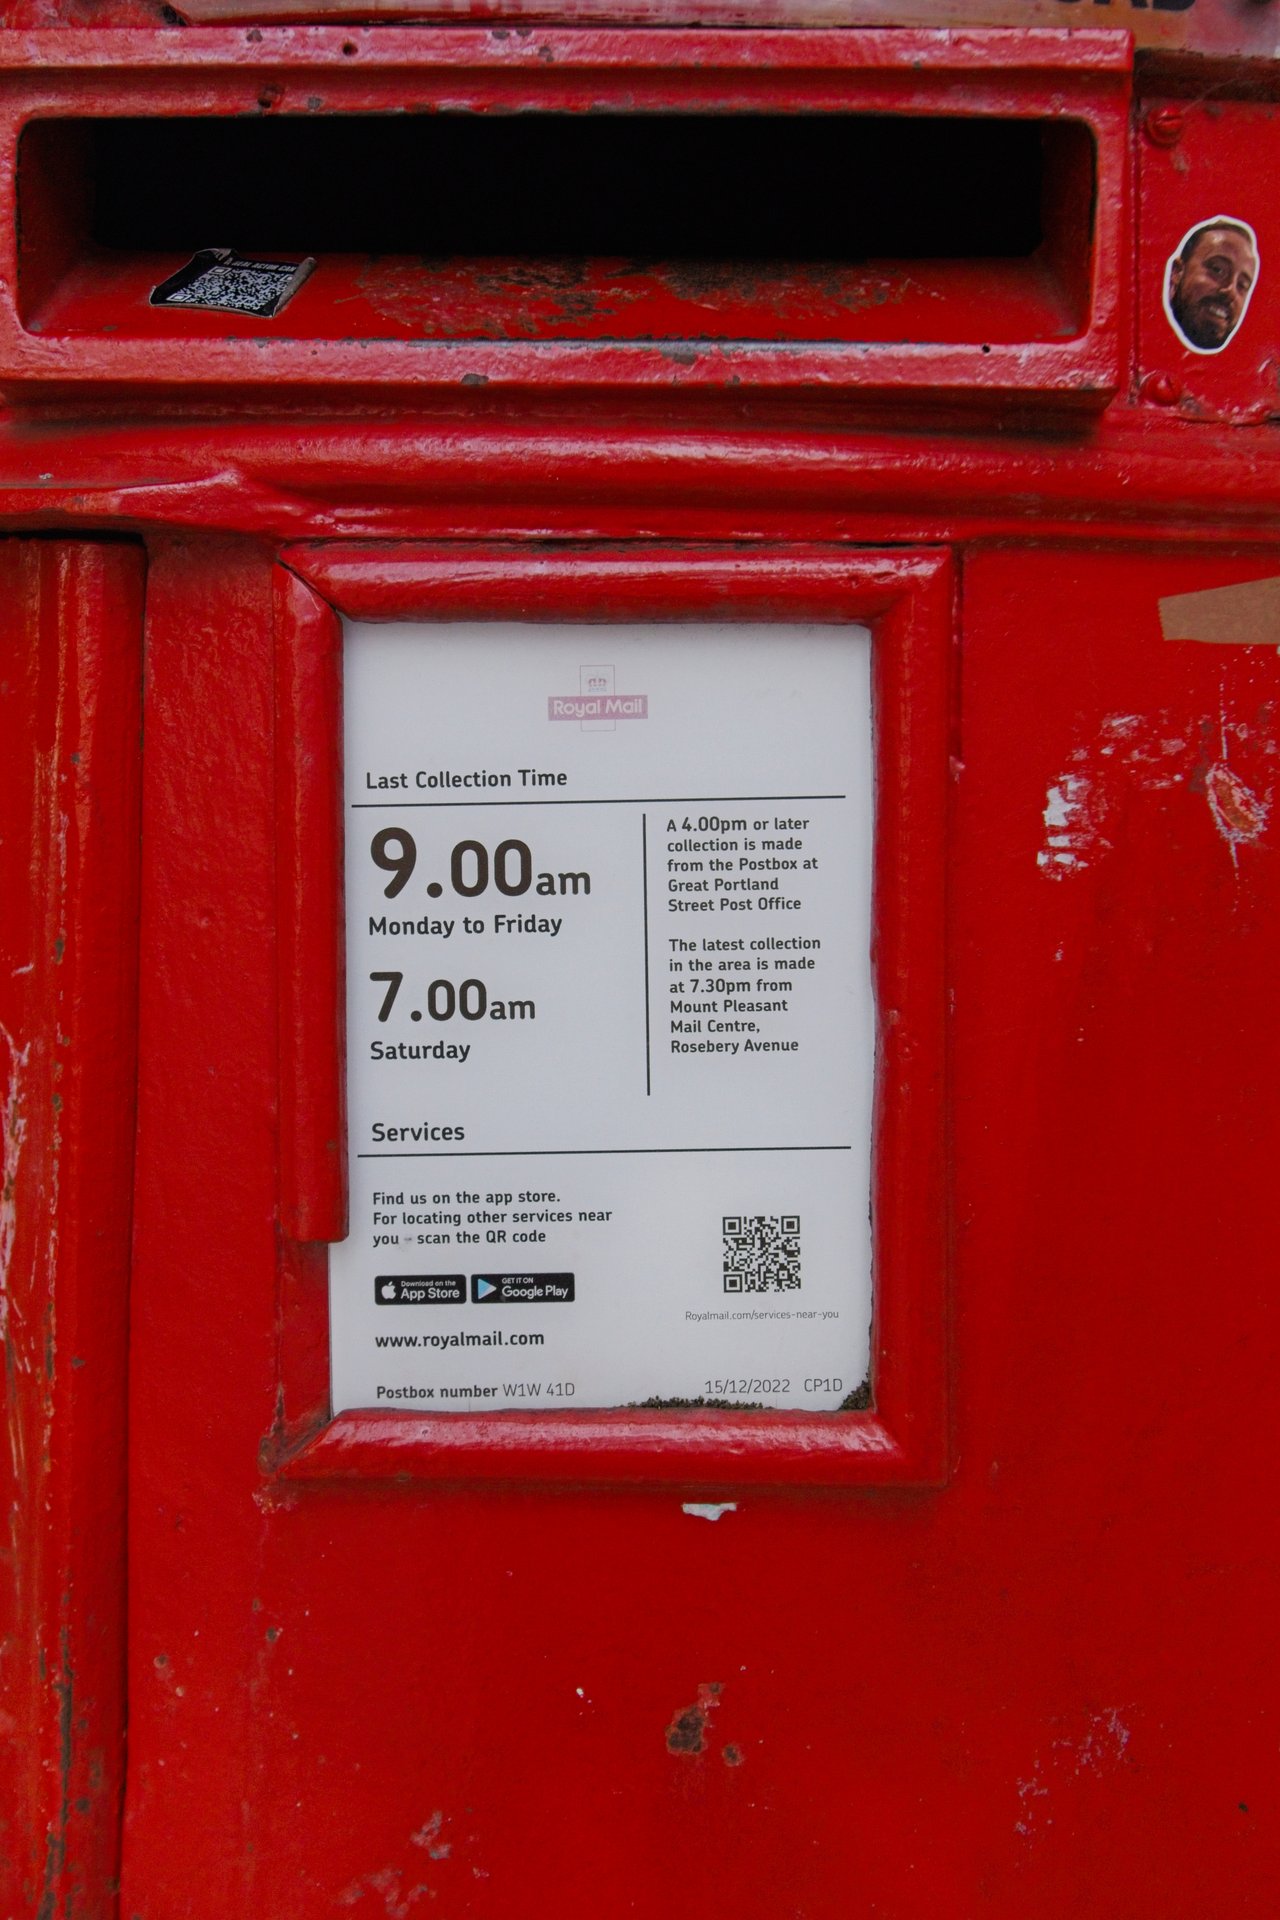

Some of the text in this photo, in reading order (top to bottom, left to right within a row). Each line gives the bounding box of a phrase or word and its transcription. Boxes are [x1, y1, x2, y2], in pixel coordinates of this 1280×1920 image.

[553, 698, 642, 718] Royal Mail
[367, 769, 567, 789] Last Collection Time
[667, 816, 810, 834] A 4.00pm or later
[668, 837, 802, 852] collection is made
[371, 827, 590, 899] 9.00am
[667, 857, 818, 872] from the Postbox at
[668, 877, 779, 892] Great Portland
[669, 897, 801, 912] Street Post Office
[369, 914, 562, 938] Monday to Friday
[669, 937, 820, 951] The latest collection
[670, 957, 815, 971] in the area is made
[670, 978, 792, 995] at 7.30pm from
[370, 972, 535, 1022] 7.00am
[671, 1000, 788, 1013] Mount Pleasant
[671, 1020, 760, 1033] Mail Centre,
[371, 1040, 470, 1062] Saturday
[671, 1039, 798, 1055] Rosebery Avenue
[372, 1122, 464, 1142] Services
[373, 1191, 560, 1206] Find us on the app store.
[374, 1209, 612, 1226] For locating other services near
[373, 1235, 399, 1248] you
[417, 1234, 450, 1244] scan
[456, 1231, 480, 1243] the
[486, 1230, 506, 1243] QR
[513, 1230, 546, 1242] code
[401, 1287, 460, 1301] App Store
[502, 1285, 568, 1299] Google Play
[686, 1310, 839, 1322] Royalmail.com/services-near-you
[375, 1331, 544, 1350] www.royalmail.com
[377, 1385, 498, 1399] Postbox number
[503, 1383, 574, 1397] W1W 41D
[704, 1379, 842, 1394] 15/12/2022 CP1D
